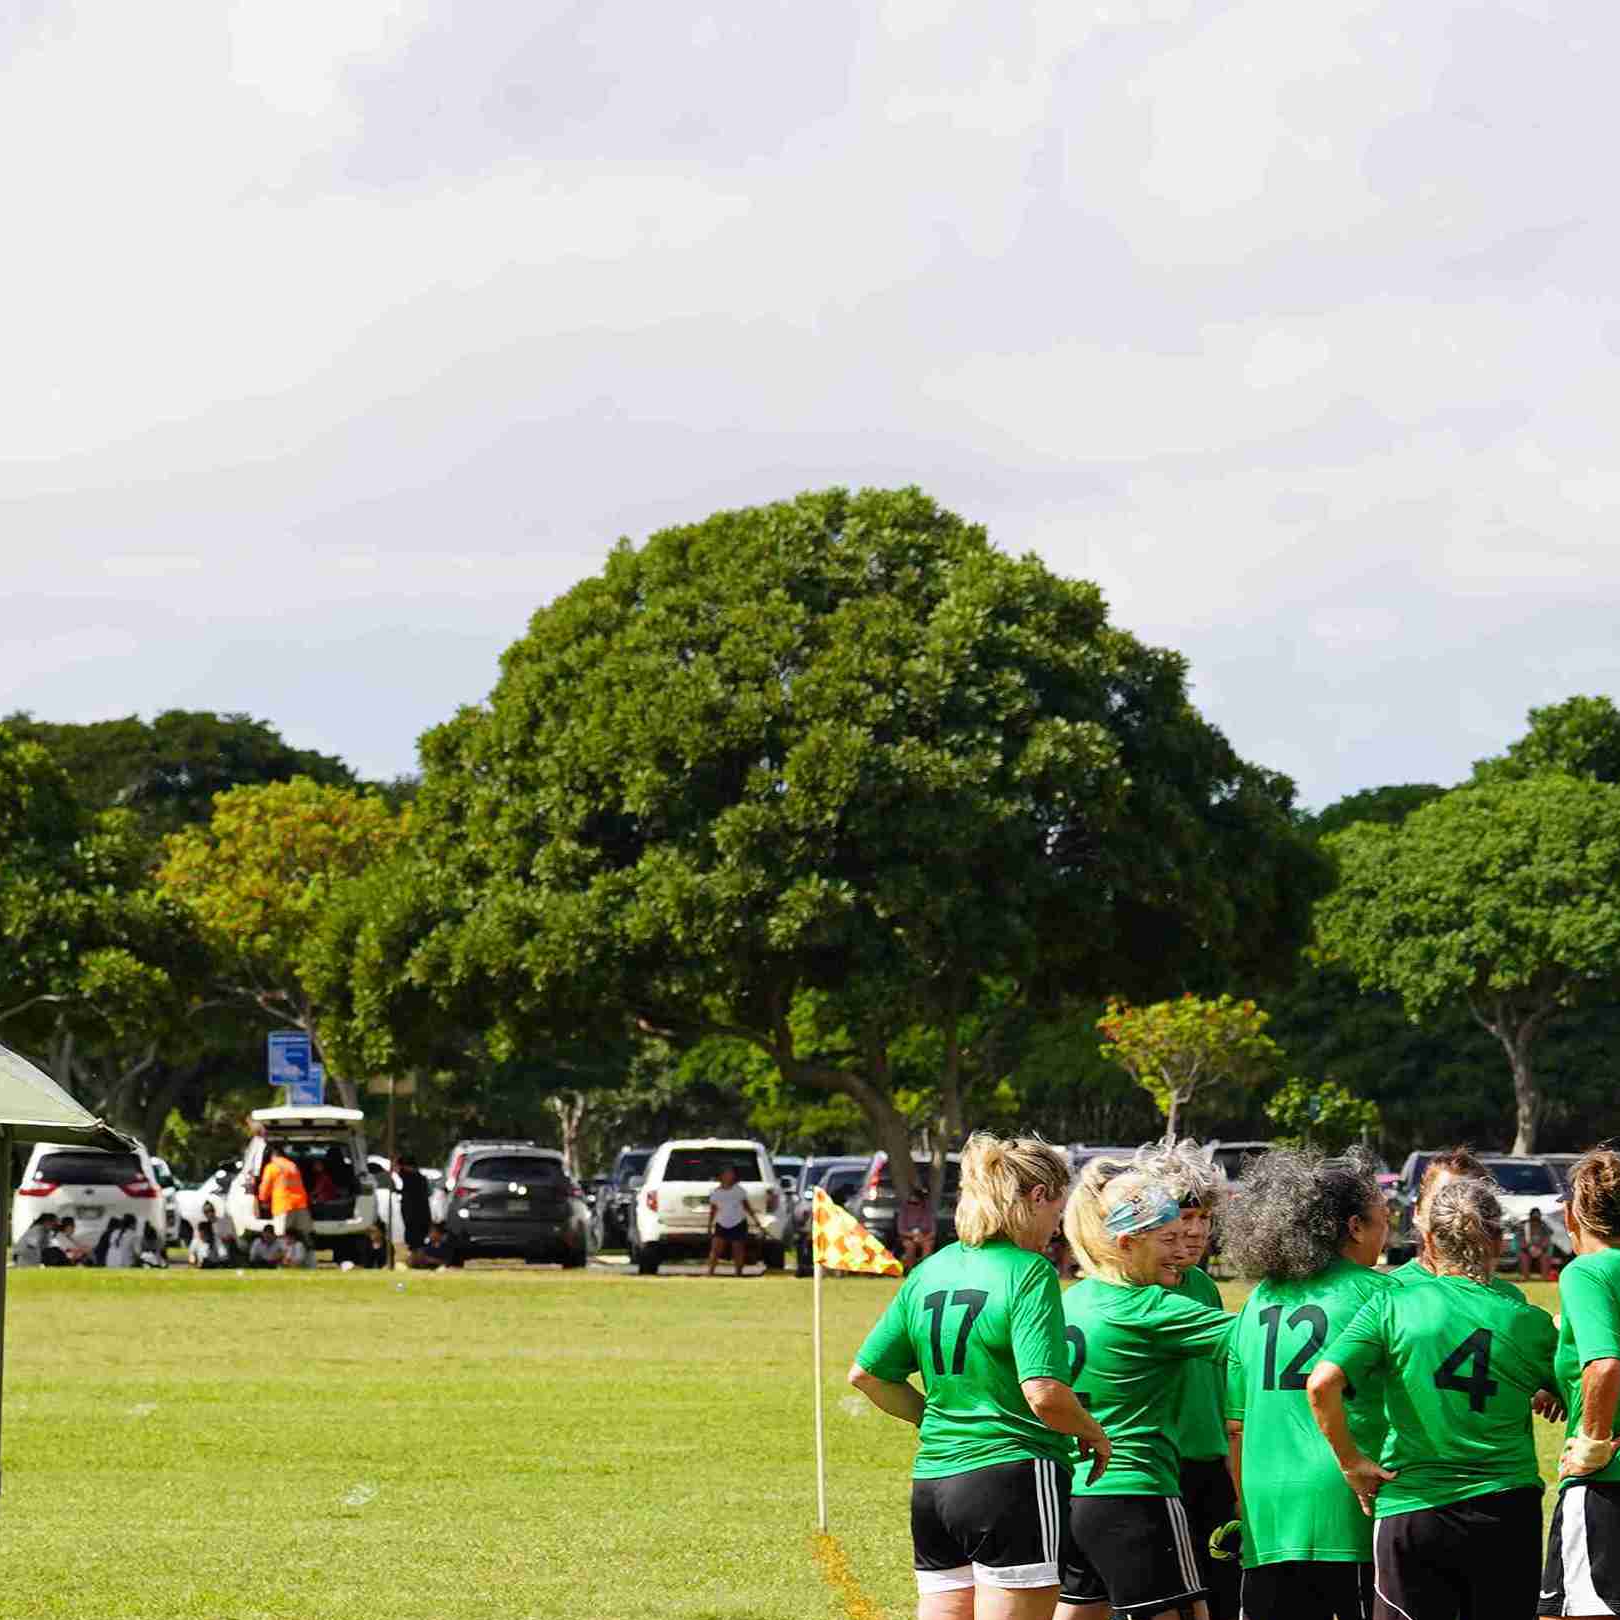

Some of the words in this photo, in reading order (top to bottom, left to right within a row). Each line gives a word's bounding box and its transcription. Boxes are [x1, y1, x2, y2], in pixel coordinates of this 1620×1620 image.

[924, 1289, 989, 1375] 17
[1259, 1305, 1329, 1391] 12
[1434, 1328, 1498, 1414] 4
